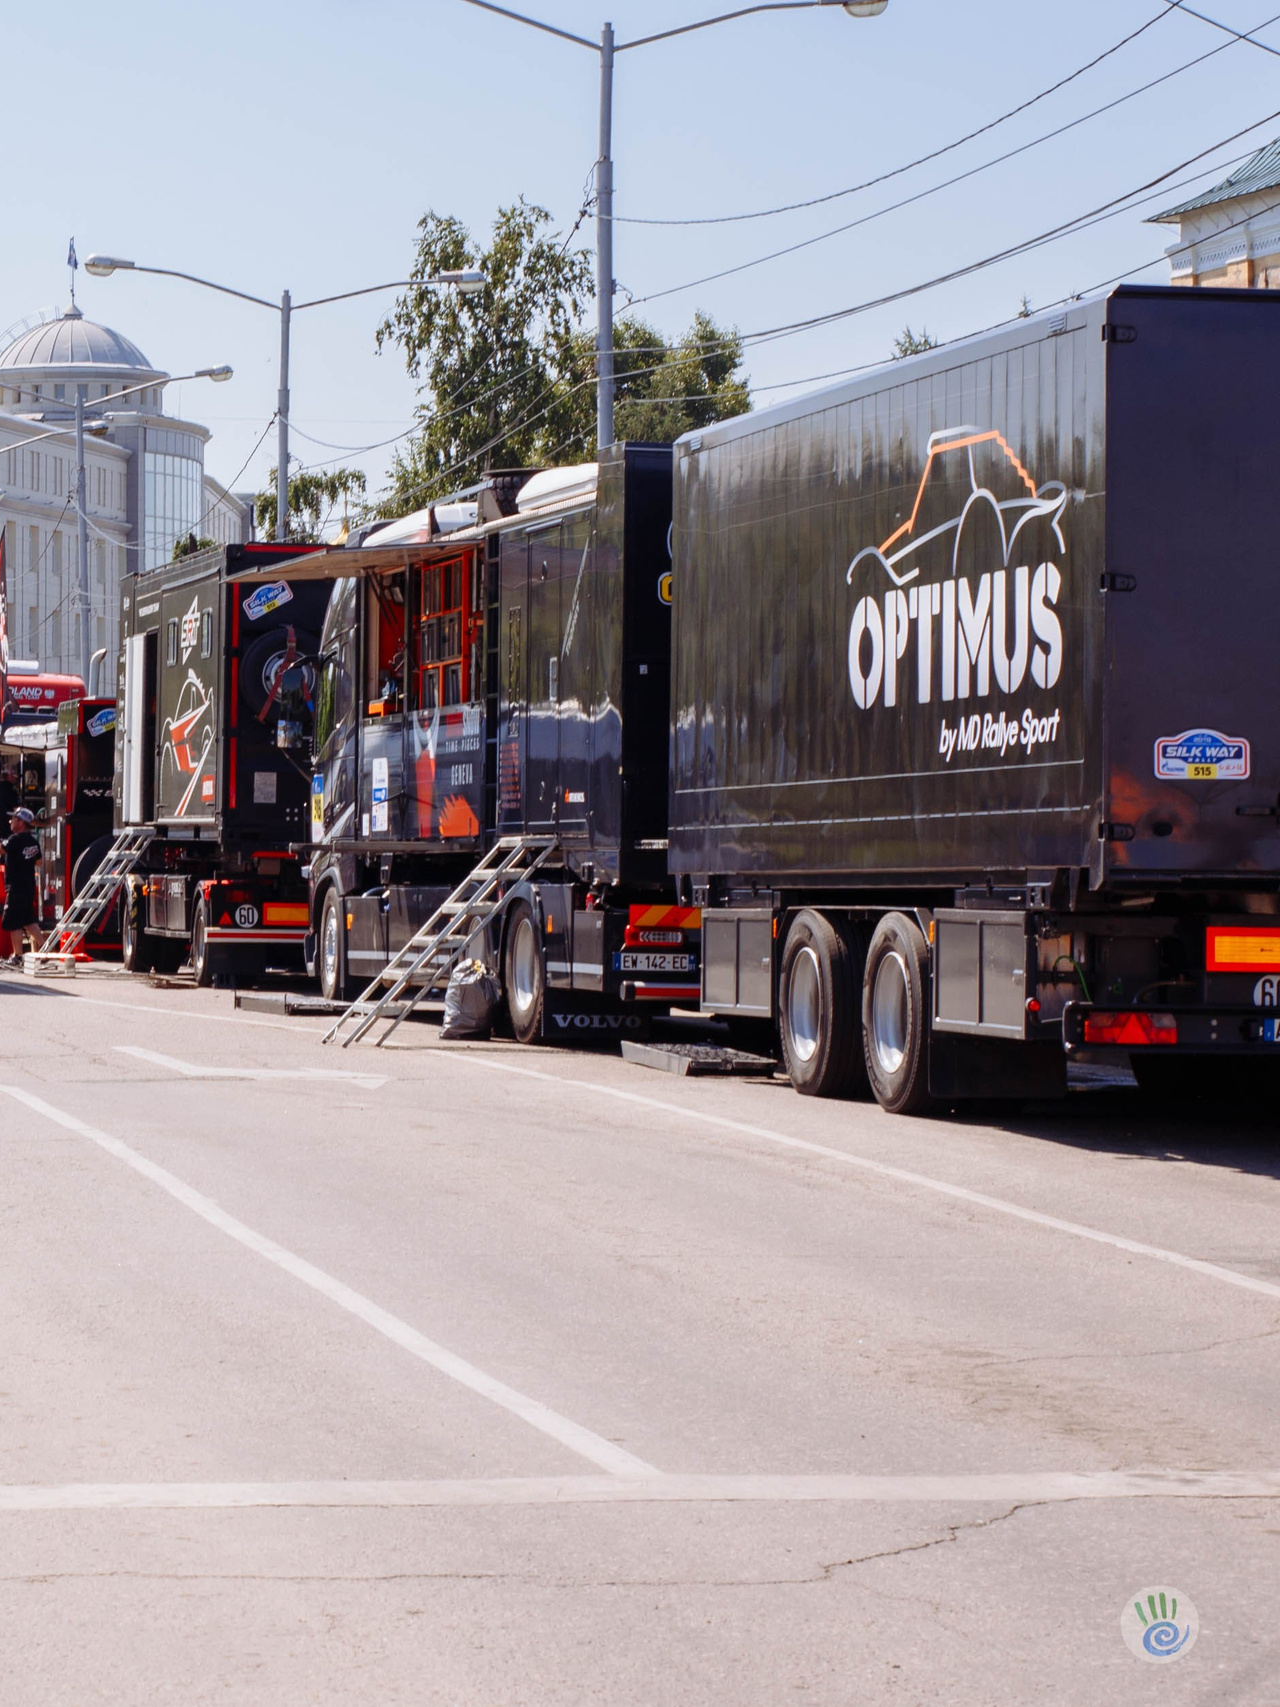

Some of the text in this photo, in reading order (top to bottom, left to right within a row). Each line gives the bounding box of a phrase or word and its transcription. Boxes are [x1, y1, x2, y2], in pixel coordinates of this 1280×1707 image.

[848, 561, 1063, 710] OPTIMUS
[938, 708, 1061, 762] by MD Rallye Sport
[1165, 746, 1239, 758] SILK WAY
[1193, 766, 1212, 776] 515
[239, 907, 255, 925] 60
[1261, 978, 1280, 1007] 6
[552, 1013, 642, 1028] VOLVO
